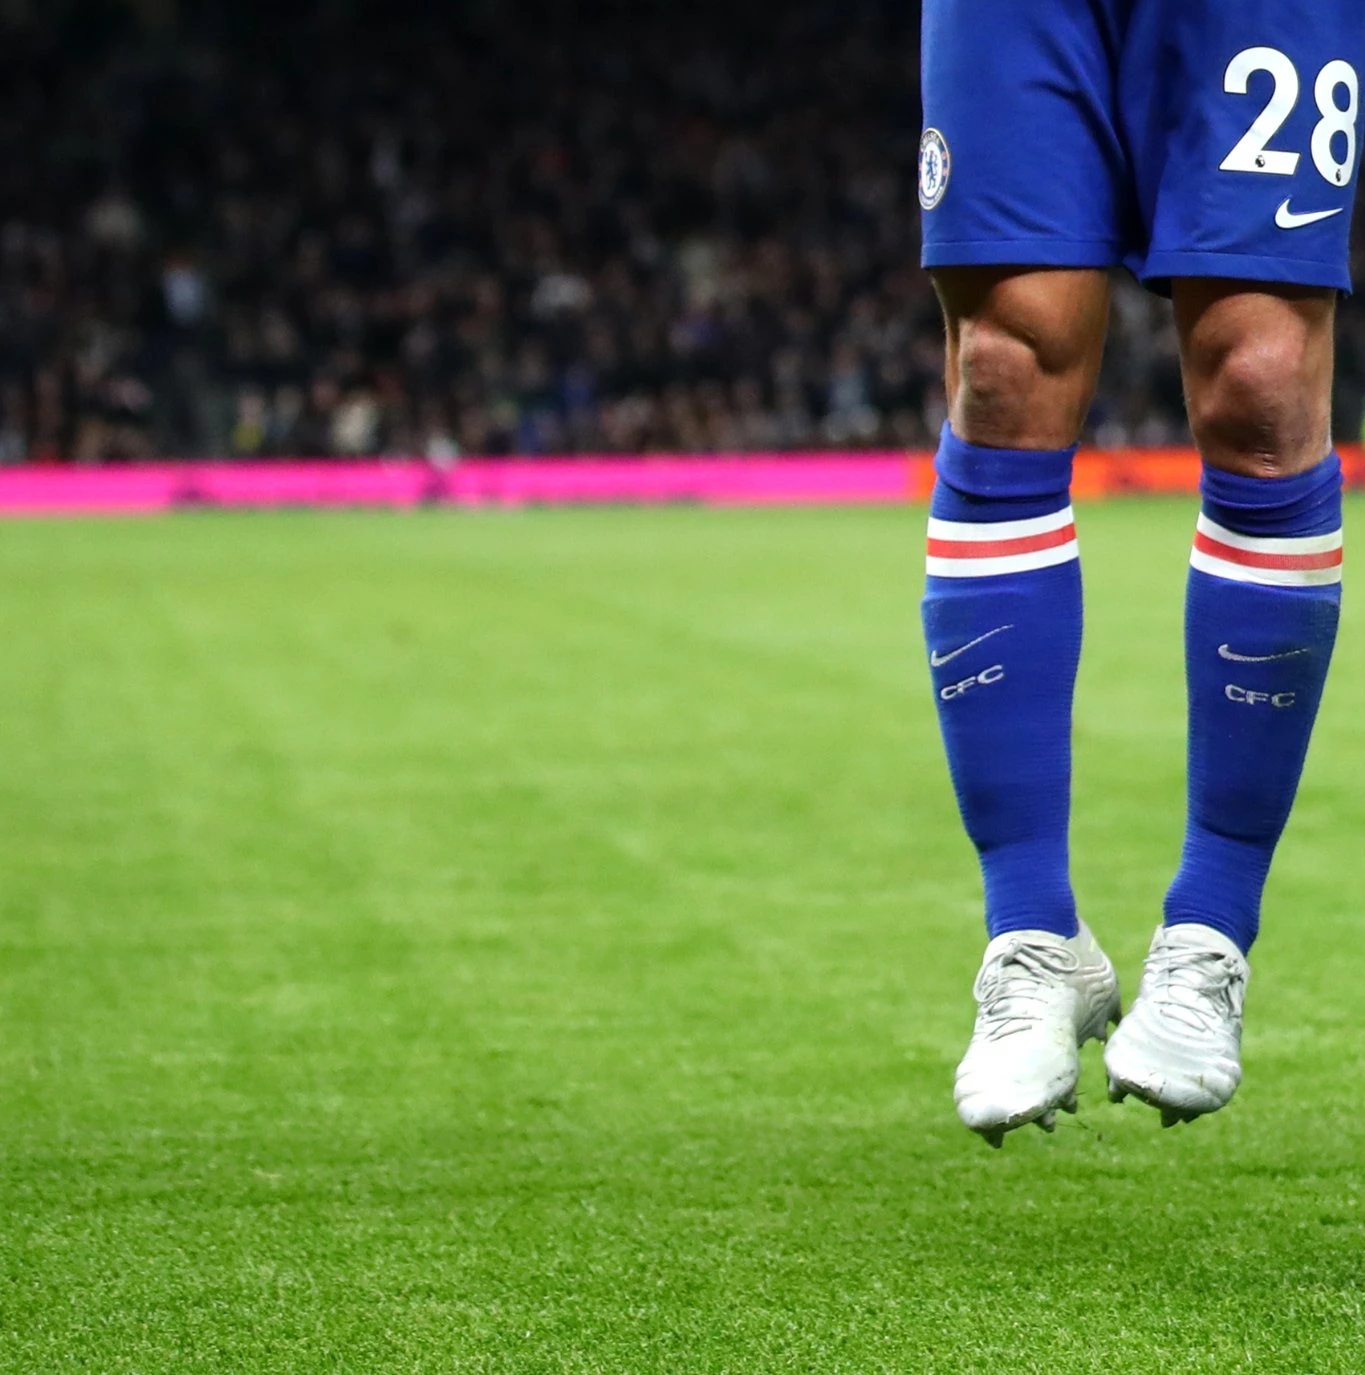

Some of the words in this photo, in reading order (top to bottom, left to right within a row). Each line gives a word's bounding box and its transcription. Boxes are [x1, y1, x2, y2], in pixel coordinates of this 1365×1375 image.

[1219, 46, 1359, 188] 28
[940, 664, 1005, 700] CFC
[1224, 684, 1296, 708] CFC
